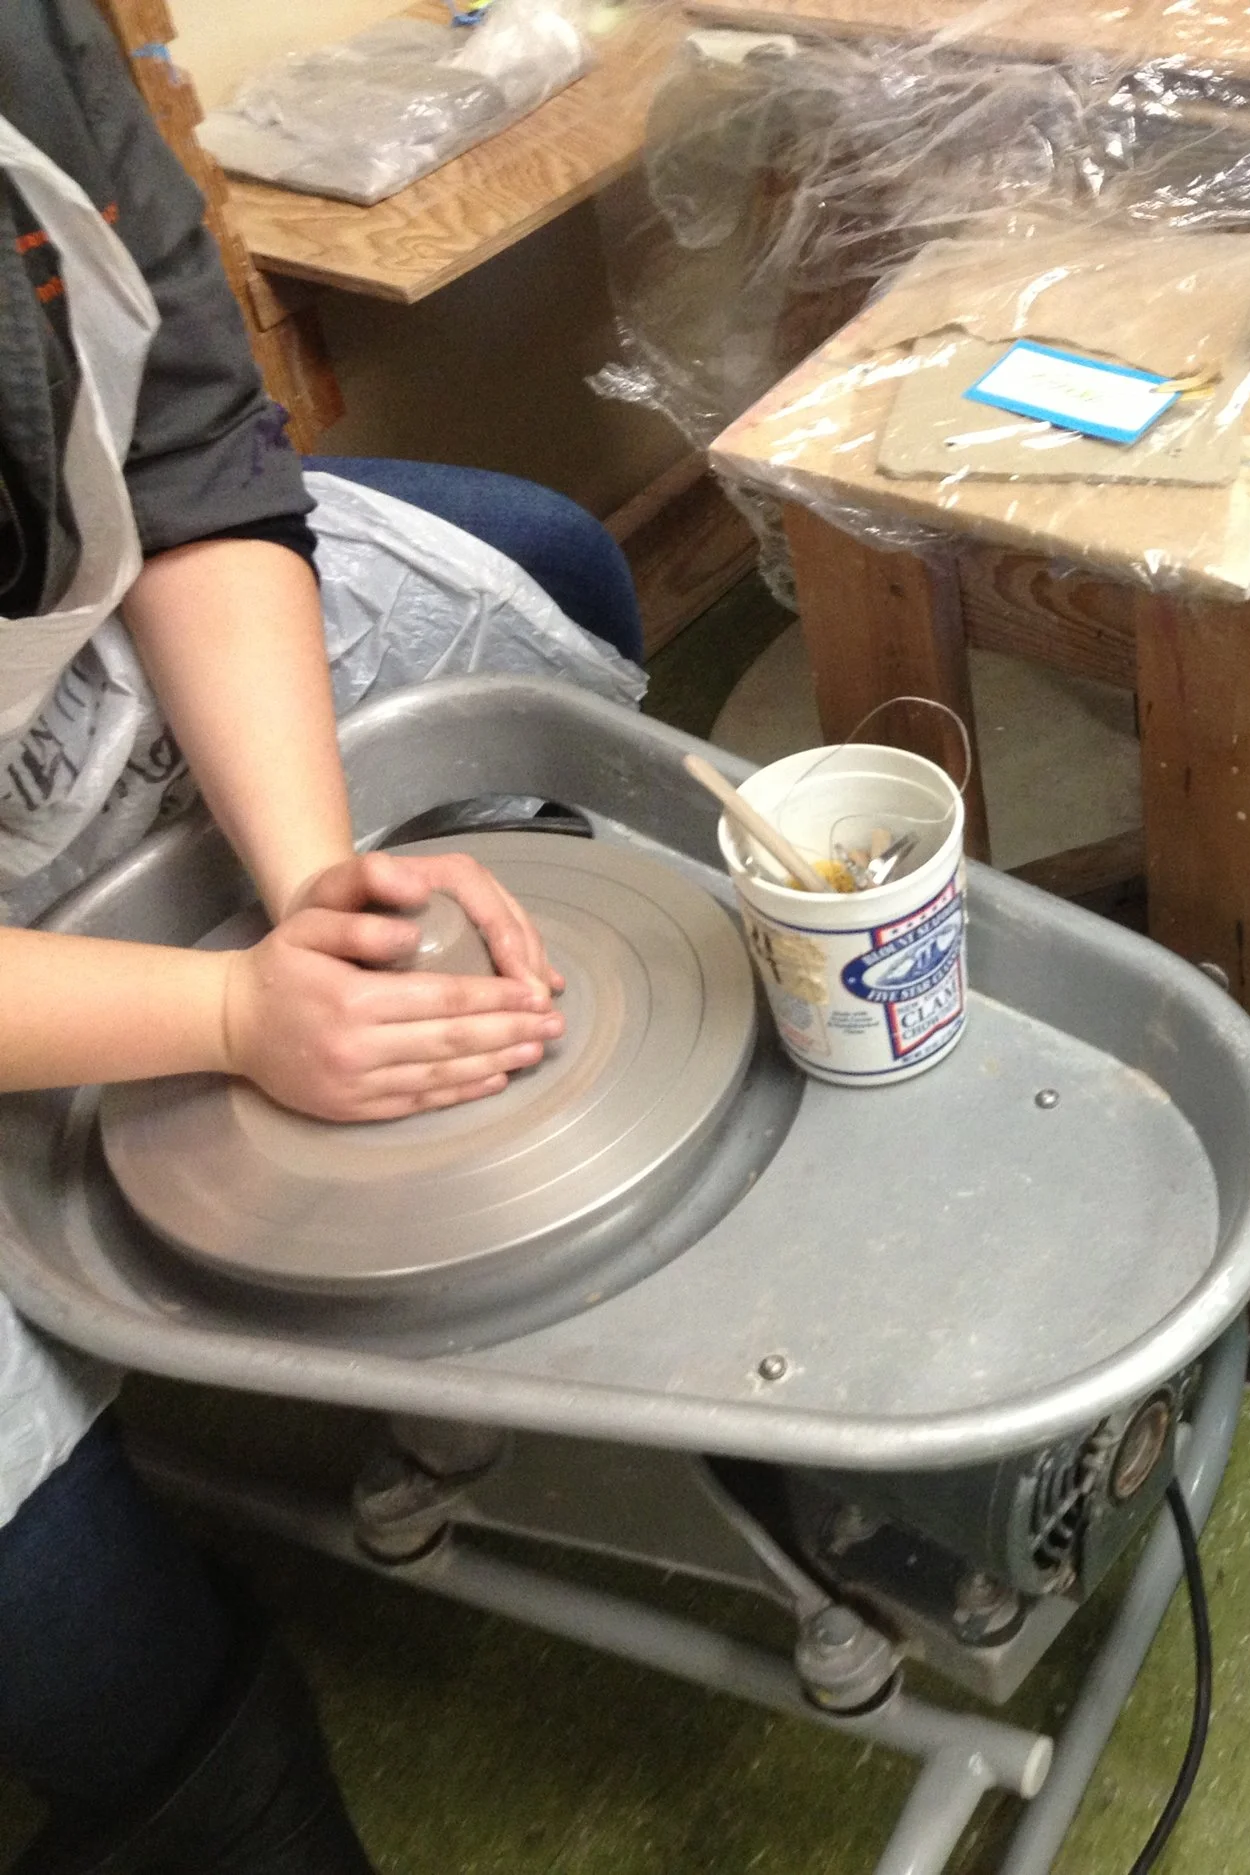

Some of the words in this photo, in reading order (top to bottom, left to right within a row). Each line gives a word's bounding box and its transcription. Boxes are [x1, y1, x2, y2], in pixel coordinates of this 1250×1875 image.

[867, 988, 899, 1002] FIVE
[901, 976, 931, 1001] STAR
[901, 979, 957, 1028] CLAM
